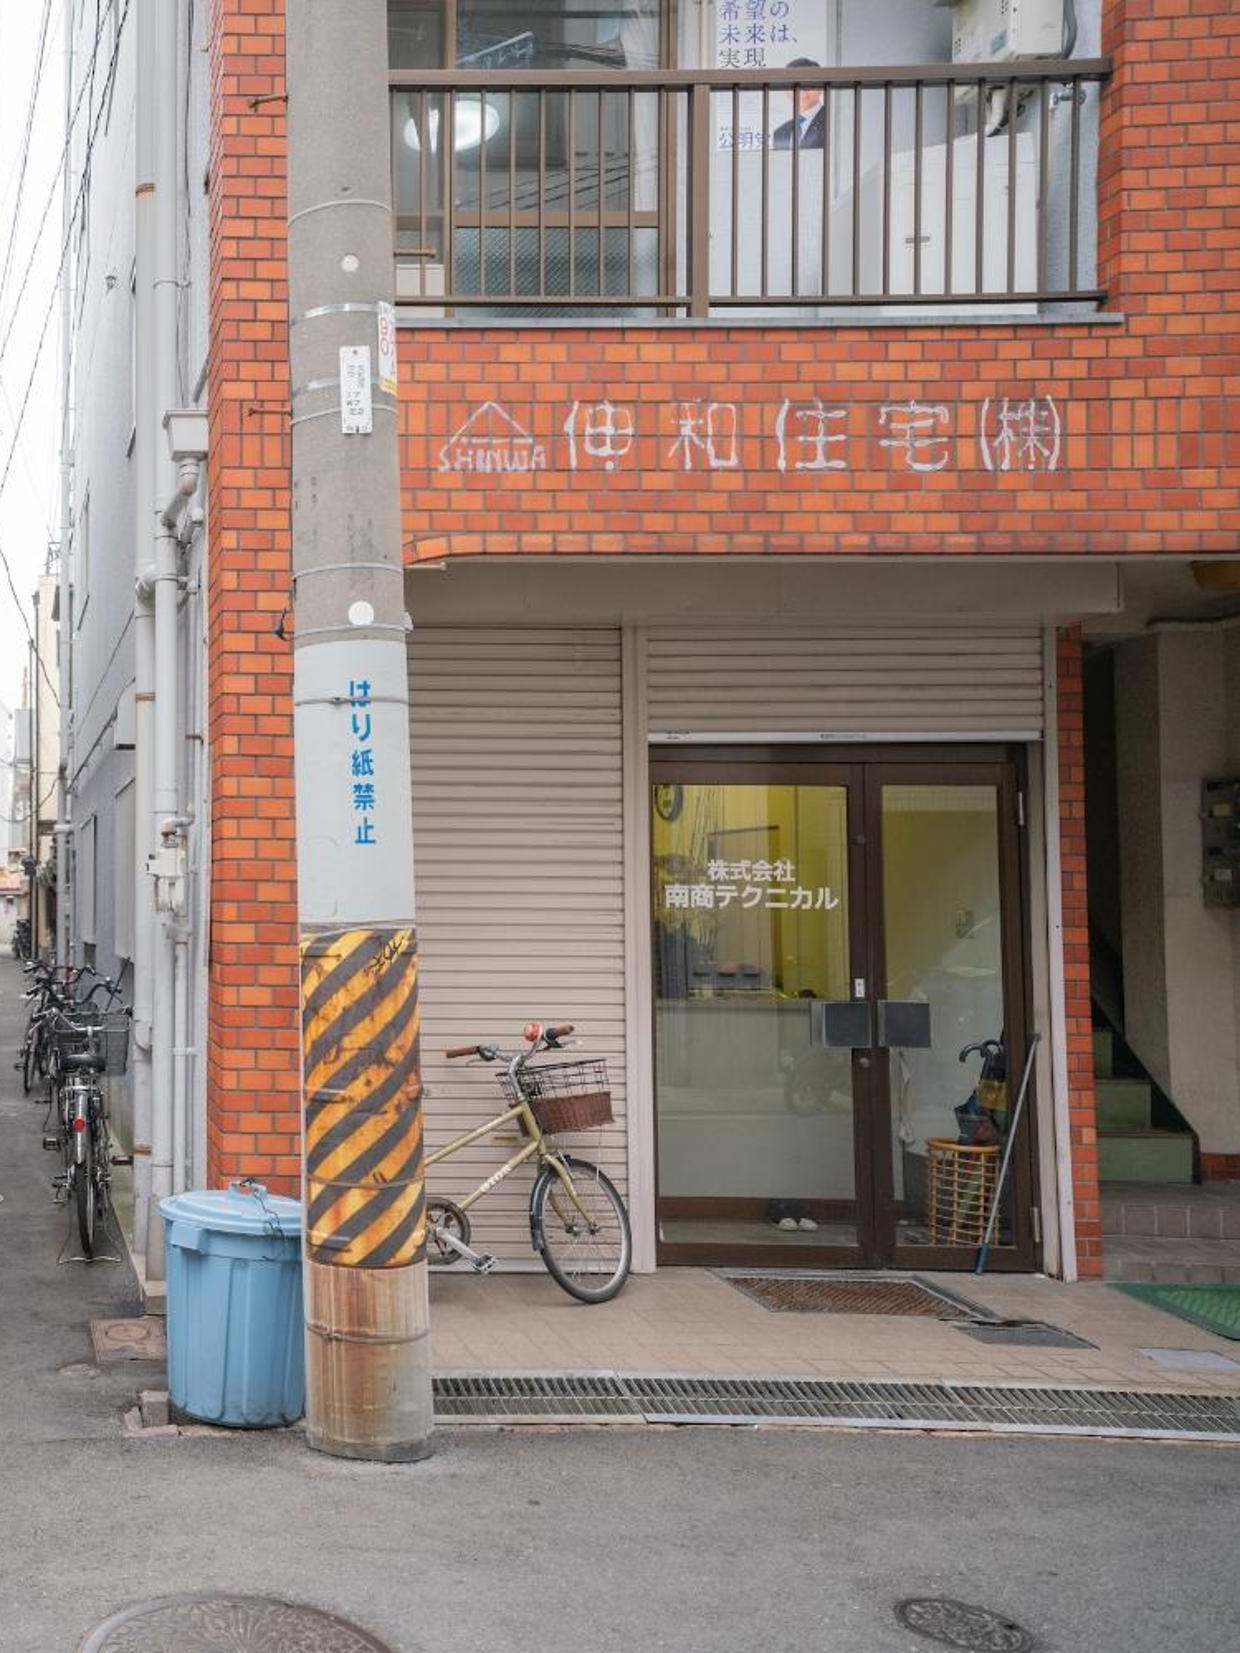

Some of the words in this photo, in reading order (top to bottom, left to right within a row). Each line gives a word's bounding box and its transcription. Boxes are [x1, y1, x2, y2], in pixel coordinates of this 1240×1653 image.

[349, 680, 376, 844] はり紙禁止
[707, 859, 796, 882] 株式会社
[664, 884, 839, 910] 南商テクニカル
